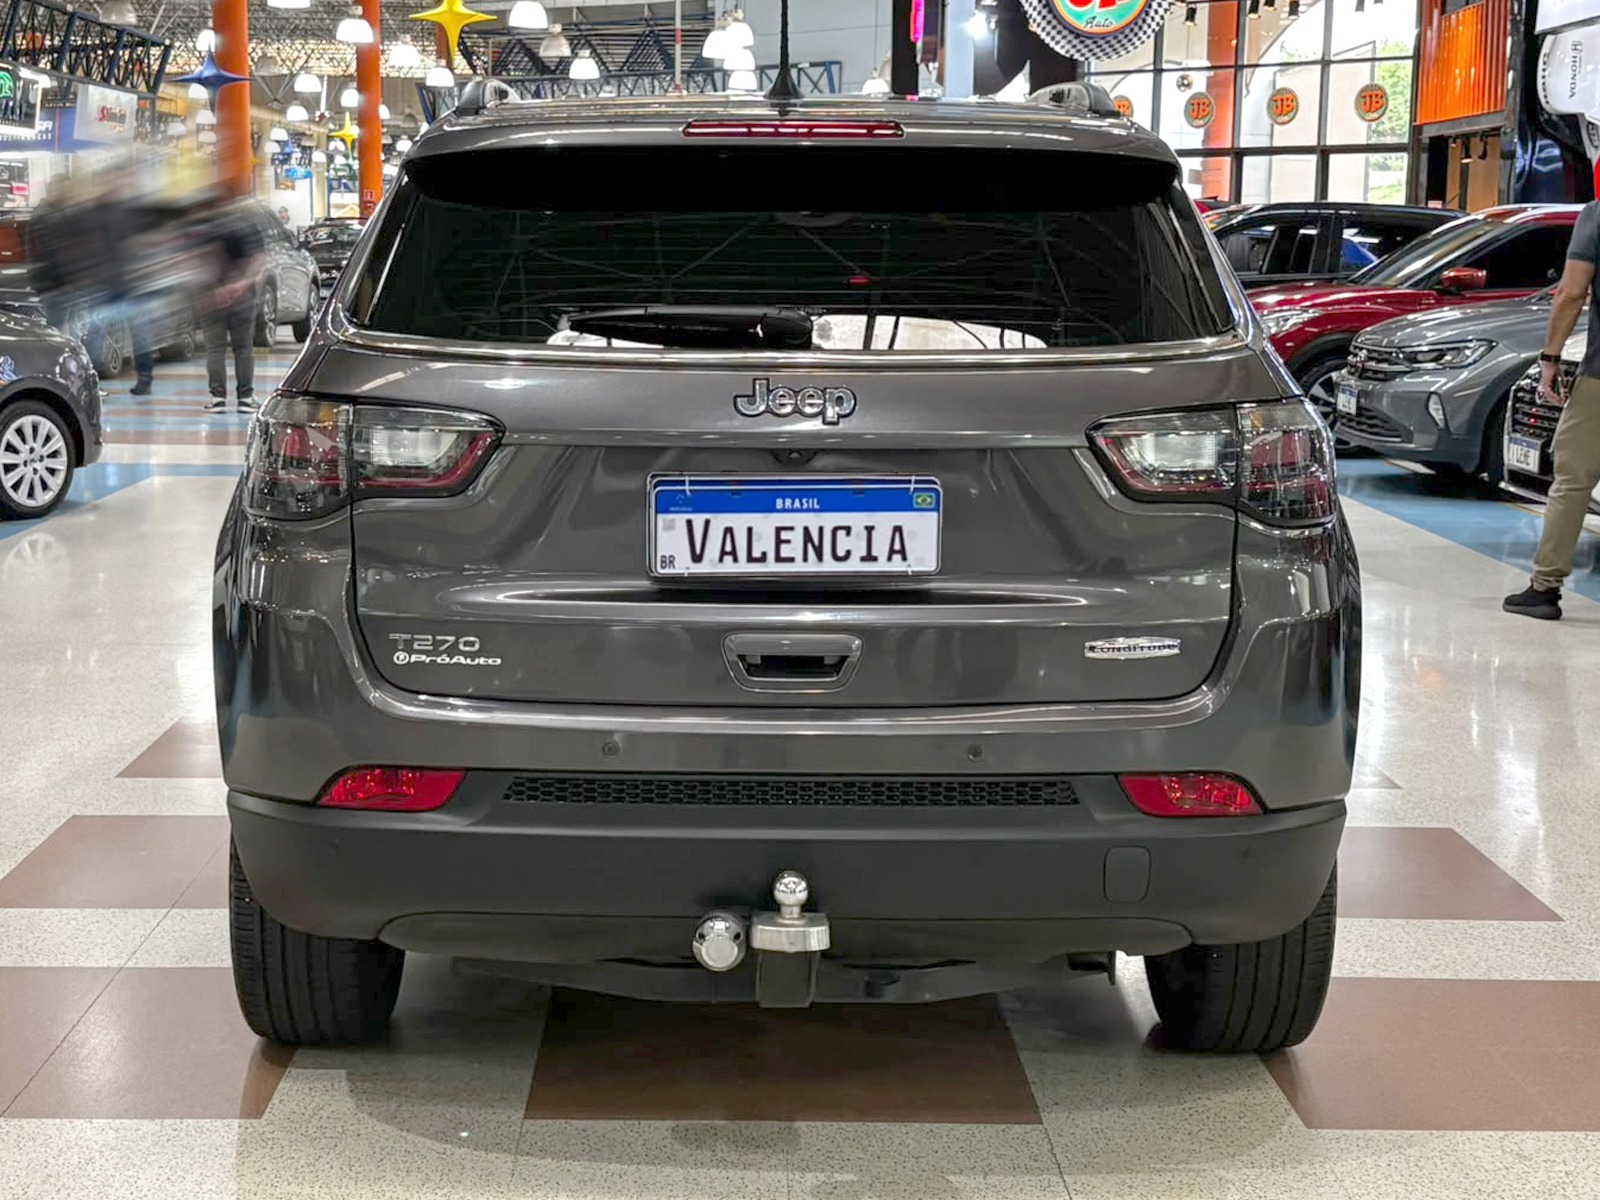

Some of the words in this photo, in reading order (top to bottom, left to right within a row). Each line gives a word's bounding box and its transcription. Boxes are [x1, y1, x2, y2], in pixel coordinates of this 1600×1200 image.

[1083, 15, 1114, 29] Auto
[1569, 55, 1578, 99] HONDA
[1189, 99, 1211, 120] JB
[1271, 93, 1296, 116] JB
[1361, 90, 1385, 113] JB
[733, 377, 857, 425] Jeep
[775, 498, 821, 510] BRASIL
[659, 554, 677, 570] BR
[388, 633, 480, 651] T270
